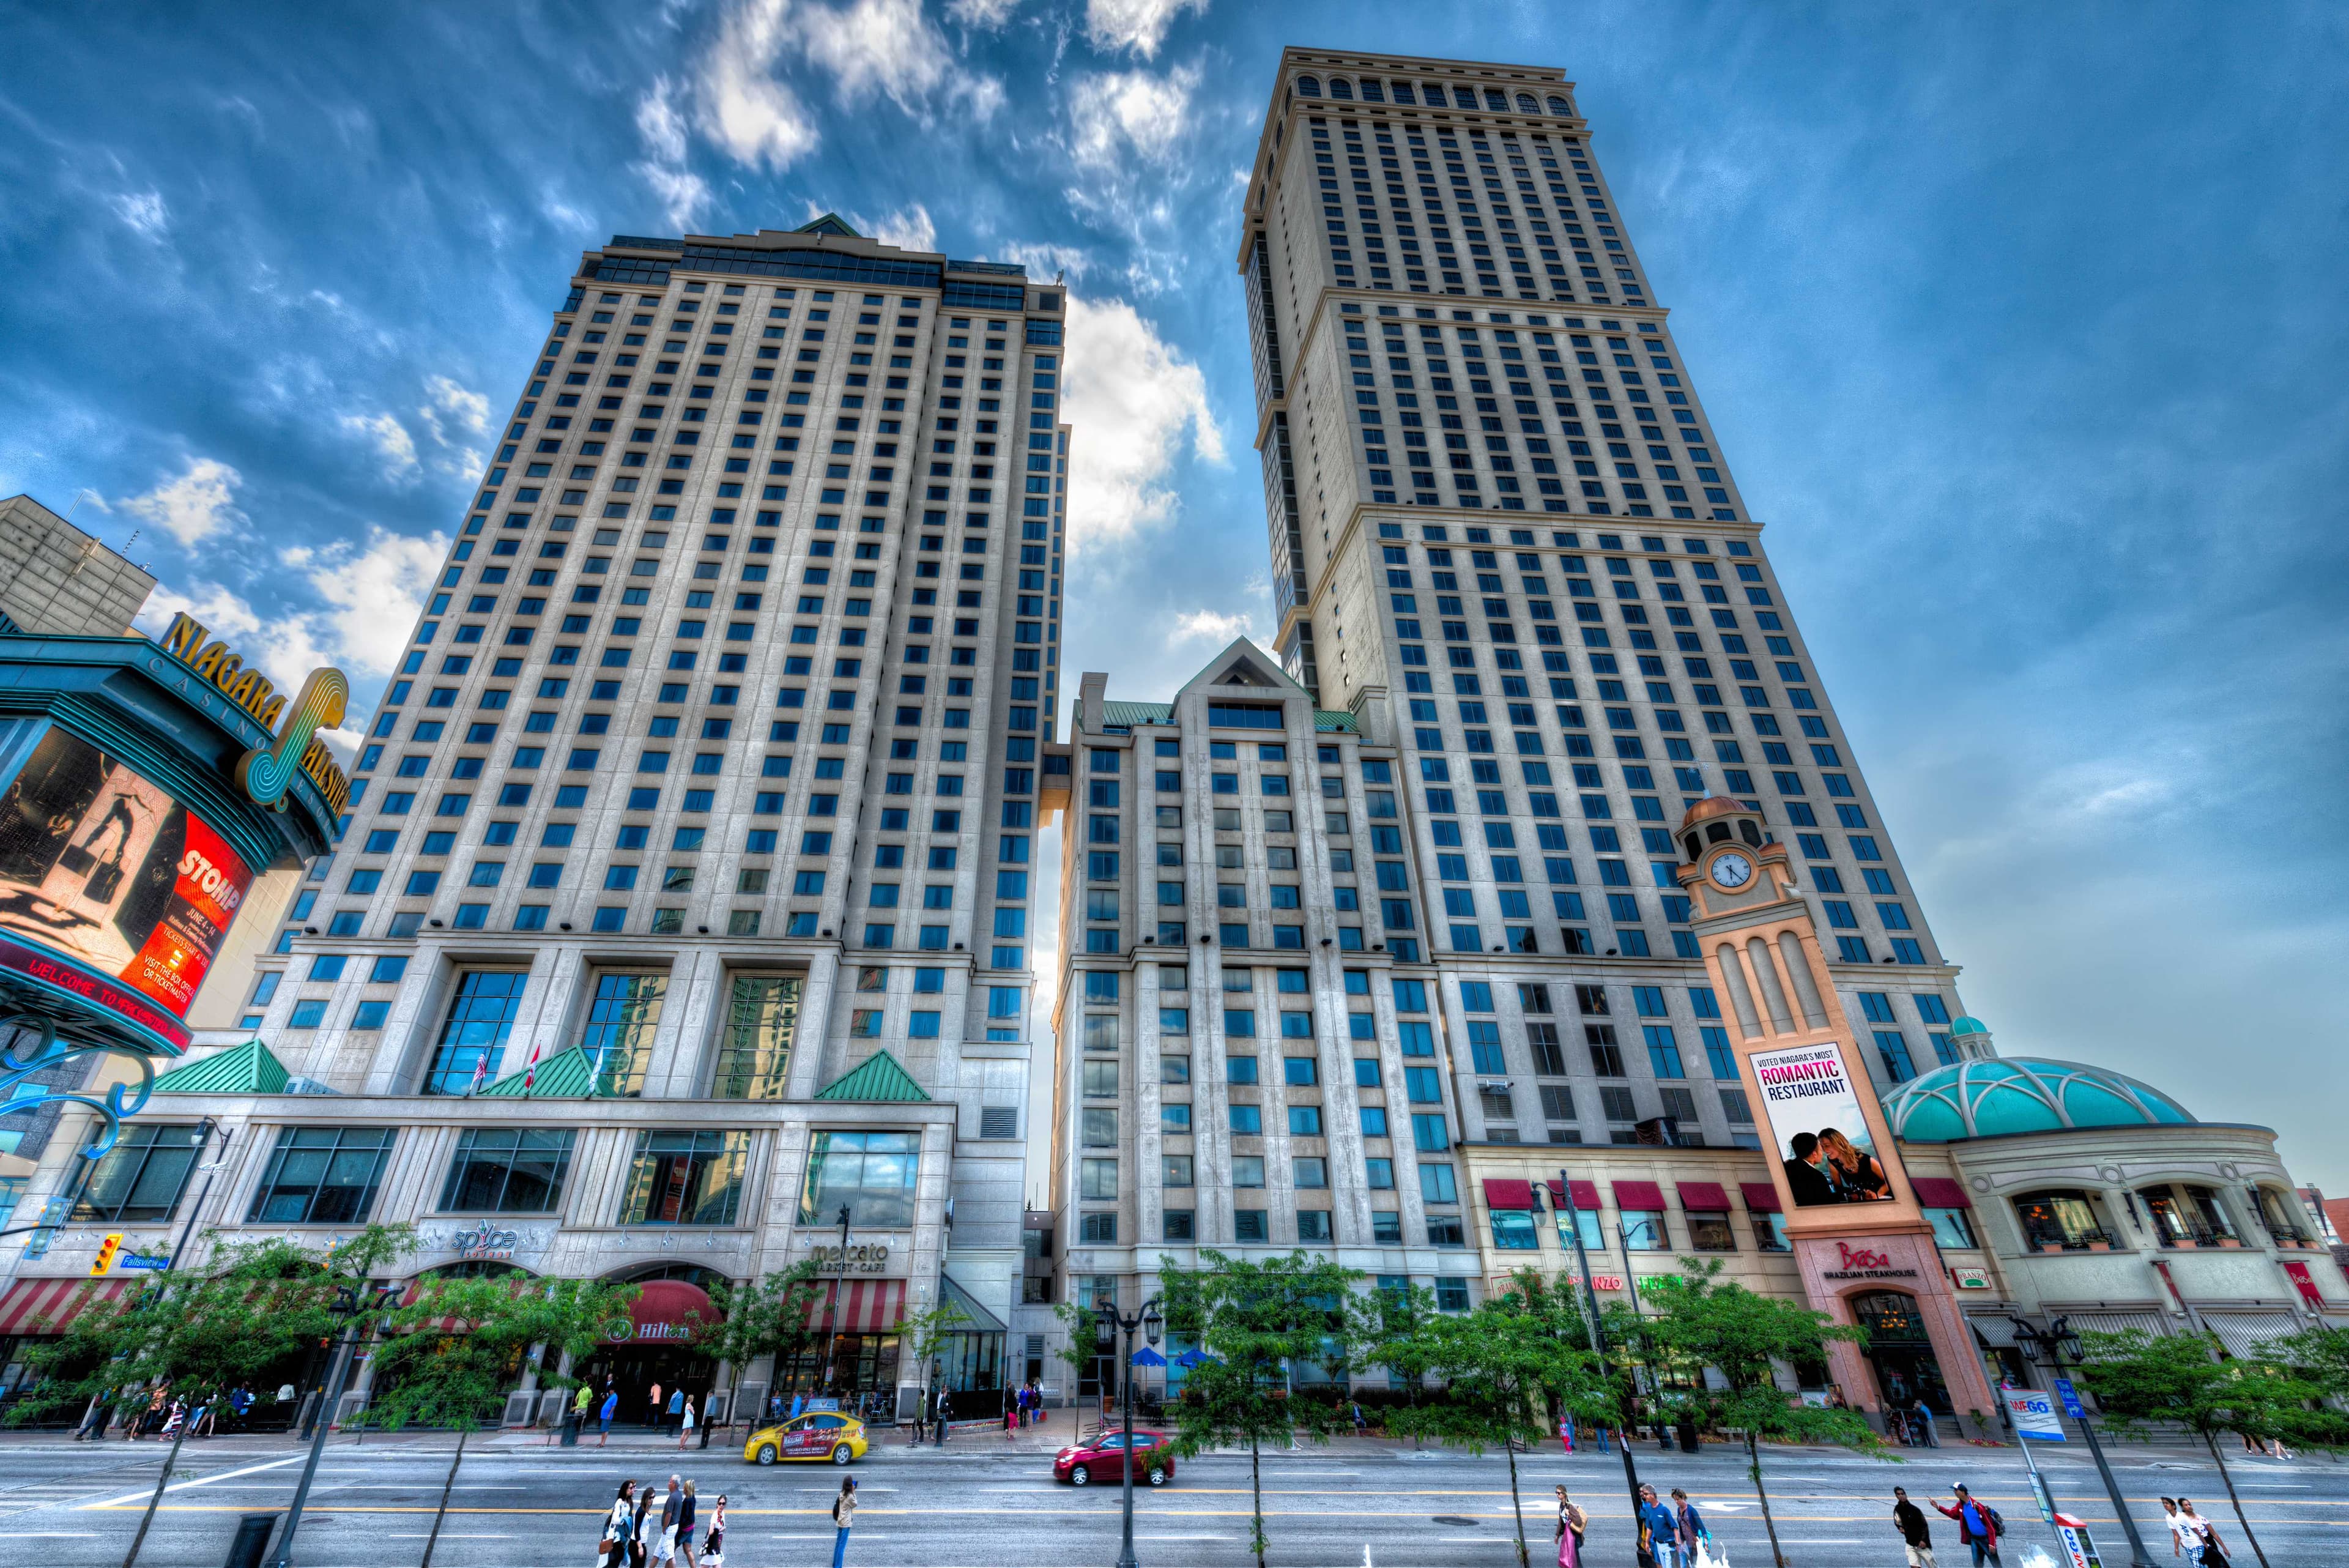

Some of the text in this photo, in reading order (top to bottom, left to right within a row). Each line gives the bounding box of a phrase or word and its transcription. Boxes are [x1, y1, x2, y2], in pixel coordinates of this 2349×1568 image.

[160, 612, 289, 734] NIAGARA
[149, 658, 265, 750] CASINO
[296, 778, 336, 843] ESORT
[177, 850, 240, 912] STOMP
[187, 908, 205, 925] JUNE
[202, 920, 208, 929] 4
[208, 926, 216, 937] 14
[163, 926, 184, 947] TICKETS
[183, 942, 198, 956] START
[29, 959, 95, 996] WELCOME
[102, 989, 117, 1005] TO
[143, 968, 188, 1004] OR TICKETMASTER
[144, 954, 195, 997] VISIT THE BOX OFFICE
[1757, 1050, 1834, 1068] VOTED NIAGARA'S MOST
[1760, 1060, 1839, 1086] ROMANTIC
[1768, 1079, 1846, 1101] RESTAURANT
[123, 1257, 158, 1267] Fallsview
[861, 1263, 886, 1272] CAFE
[1836, 1241, 1891, 1270] Brasa
[1824, 1269, 1918, 1279] BRAZILIAN STEAKHOUSE
[1958, 1272, 1987, 1281] PRANZO
[638, 1322, 689, 1339] Hilton
[2009, 1399, 2049, 1414] WEGO
